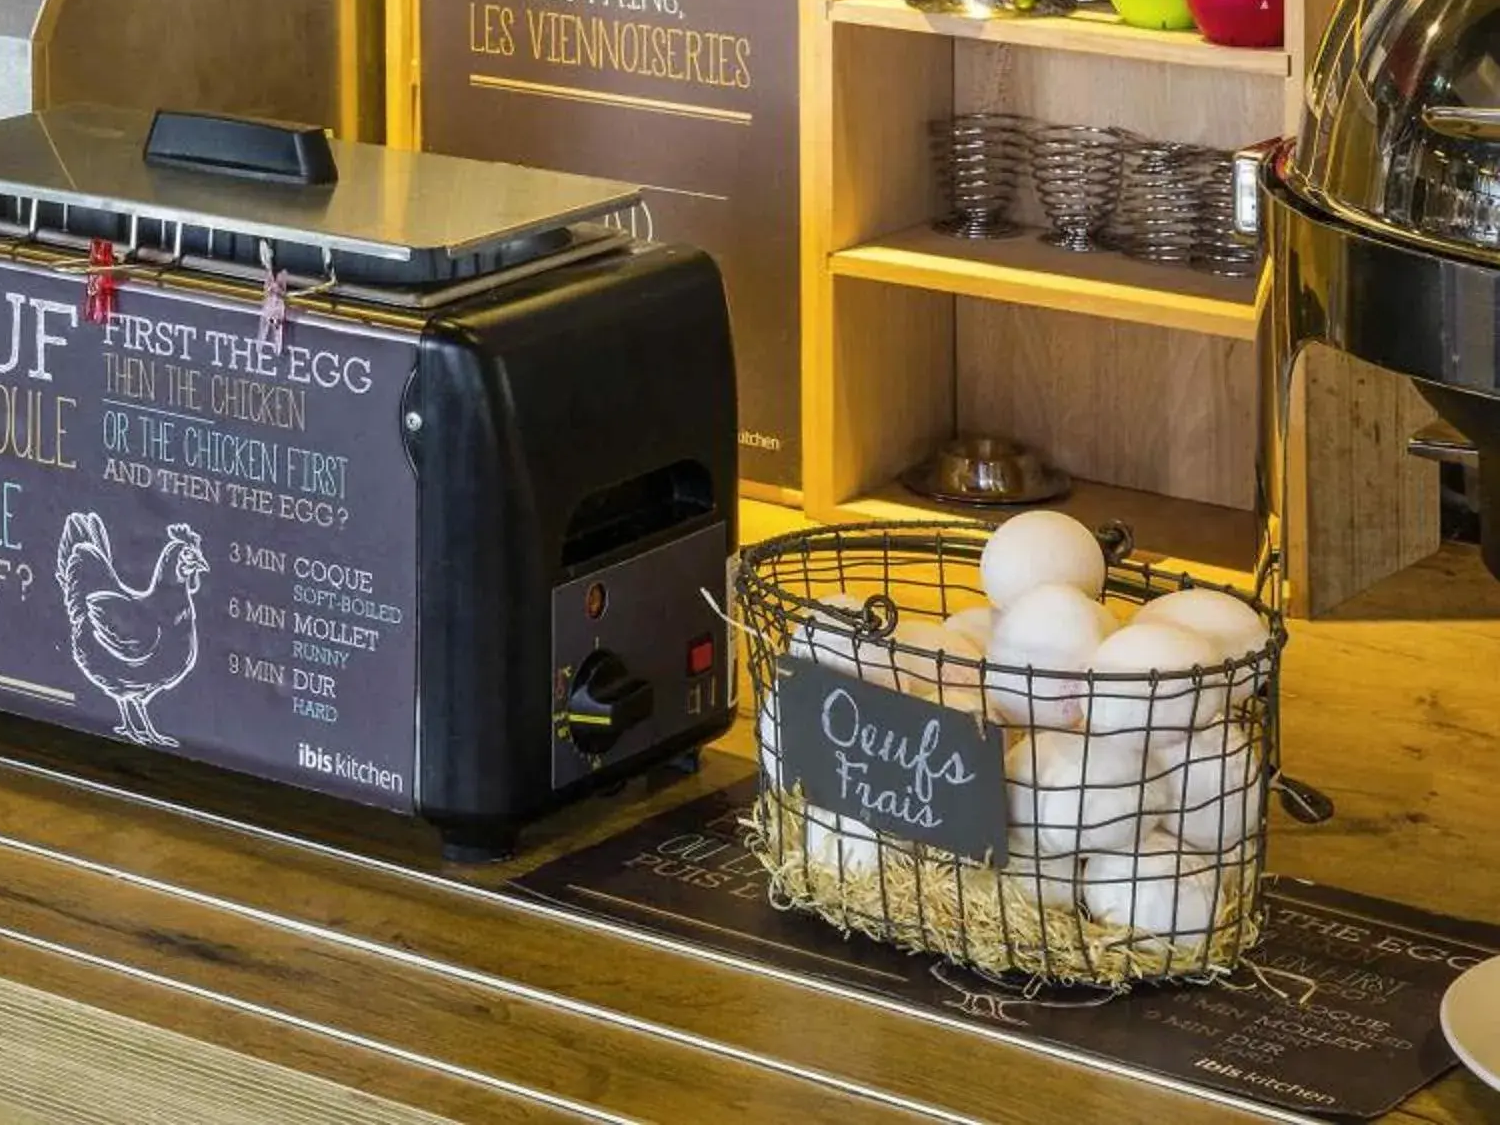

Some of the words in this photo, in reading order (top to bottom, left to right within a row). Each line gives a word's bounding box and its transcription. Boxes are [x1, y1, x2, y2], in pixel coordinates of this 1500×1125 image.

[470, 2, 515, 56] LES
[527, 9, 750, 88] VIENNOISERIES
[102, 313, 197, 361] FIRST
[205, 331, 278, 377] THE
[287, 345, 373, 394] EGG
[103, 352, 156, 401] THEN
[166, 364, 201, 411] THE
[211, 374, 306, 432] CHICKEN
[103, 410, 129, 454] OR
[139, 415, 175, 463] THE
[184, 427, 278, 484] CHICKEN
[287, 447, 349, 499] FIRST
[103, 458, 151, 489] AND
[157, 469, 221, 504] THEN
[226, 483, 274, 515] THE
[279, 495, 349, 530] EGG?
[229, 542, 241, 563] 3
[246, 544, 286, 574] MIN
[294, 557, 373, 594] COQUE
[228, 597, 240, 618] 6
[246, 600, 286, 629] MIN
[294, 612, 380, 652] MOLLET
[294, 584, 403, 625] SOFT-BOILED
[228, 653, 240, 674] 9
[245, 657, 285, 687] MIN
[292, 668, 337, 699] DUR
[292, 641, 350, 670] RUNNY
[292, 696, 338, 723] HARD
[298, 742, 333, 773] ibis
[335, 752, 404, 794] kitchen
[821, 688, 976, 803] Oeufs
[835, 750, 944, 828] Frais
[623, 852, 734, 888] PUIS
[1279, 910, 1370, 942] THE
[1194, 1057, 1244, 1078] ibis
[1244, 1072, 1336, 1105] kitchen
